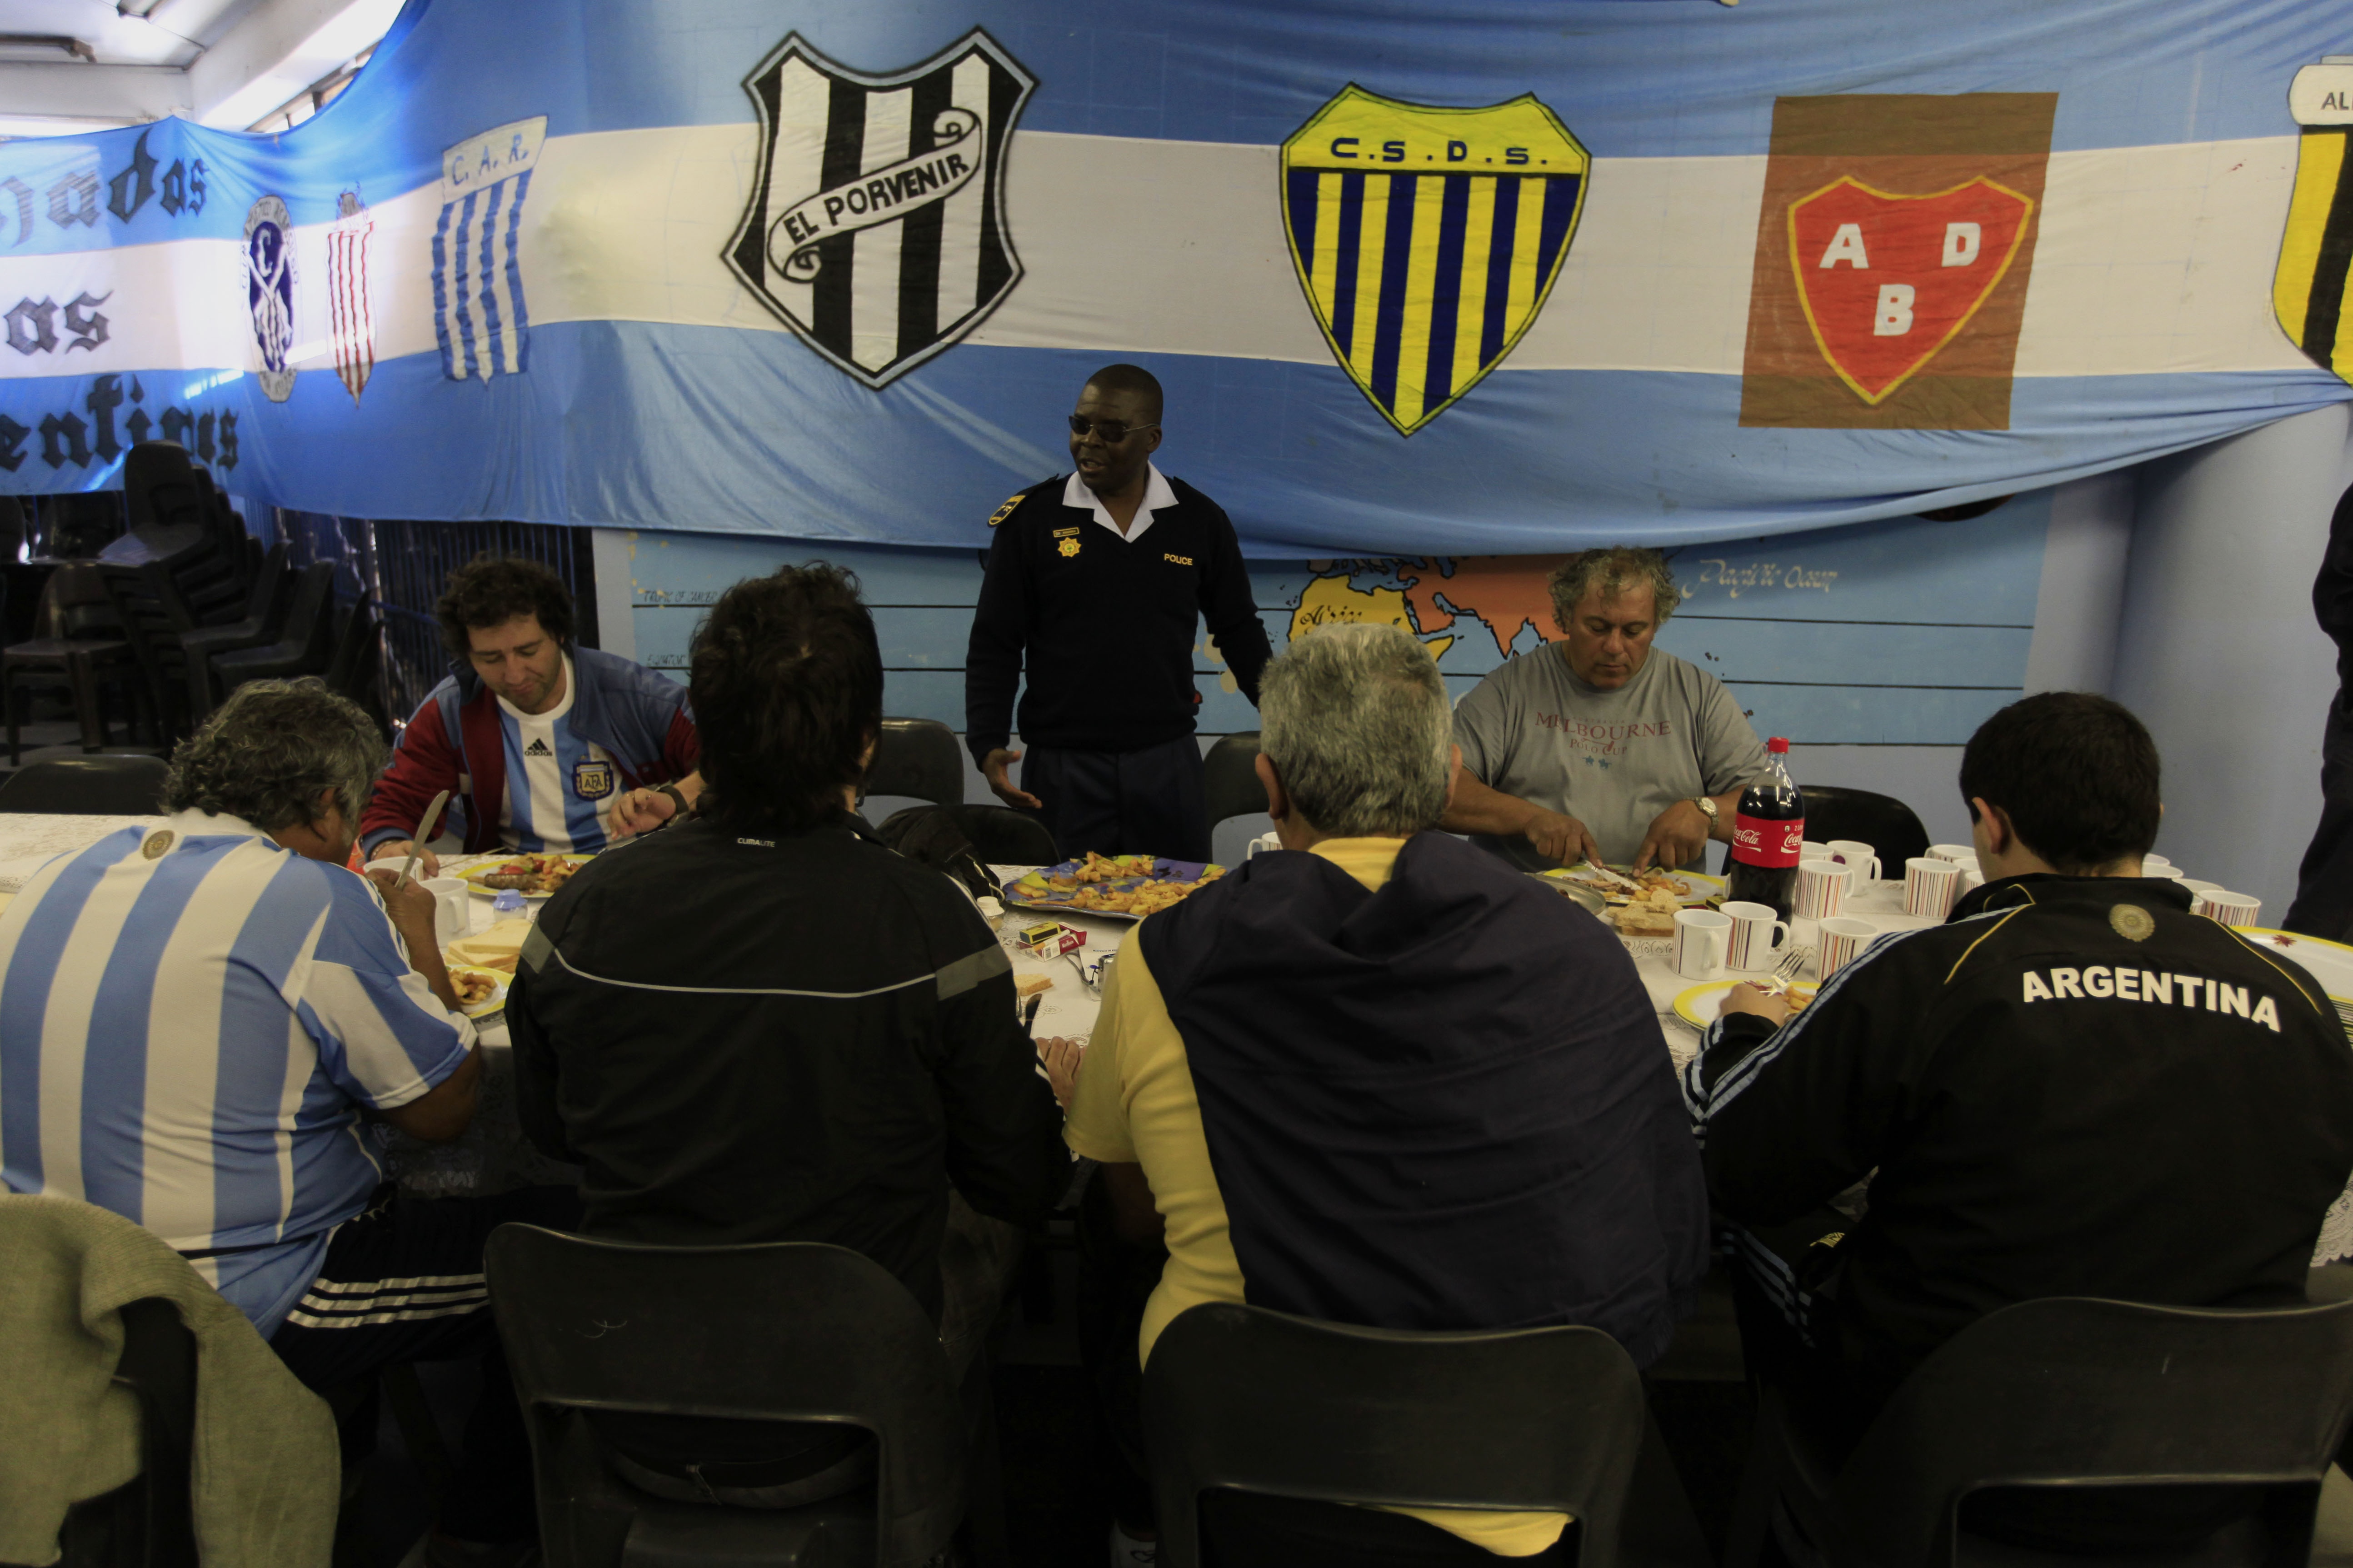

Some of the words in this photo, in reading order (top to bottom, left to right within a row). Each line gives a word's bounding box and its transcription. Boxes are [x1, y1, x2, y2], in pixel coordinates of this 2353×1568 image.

[2319, 92, 2353, 110] AL
[783, 210, 820, 245] EL
[823, 152, 969, 226] PORVENIR
[1818, 224, 1869, 269] A
[1942, 222, 1981, 267] D
[1873, 284, 1915, 336] B
[1164, 553, 1193, 565] POLICE
[1535, 712, 1671, 740] MELBOURNE
[1569, 738, 1598, 754] POLO
[1602, 745, 1627, 755] CUP
[738, 838, 775, 848] CLIMALITE
[2023, 965, 2282, 1032] ARGENTINA
